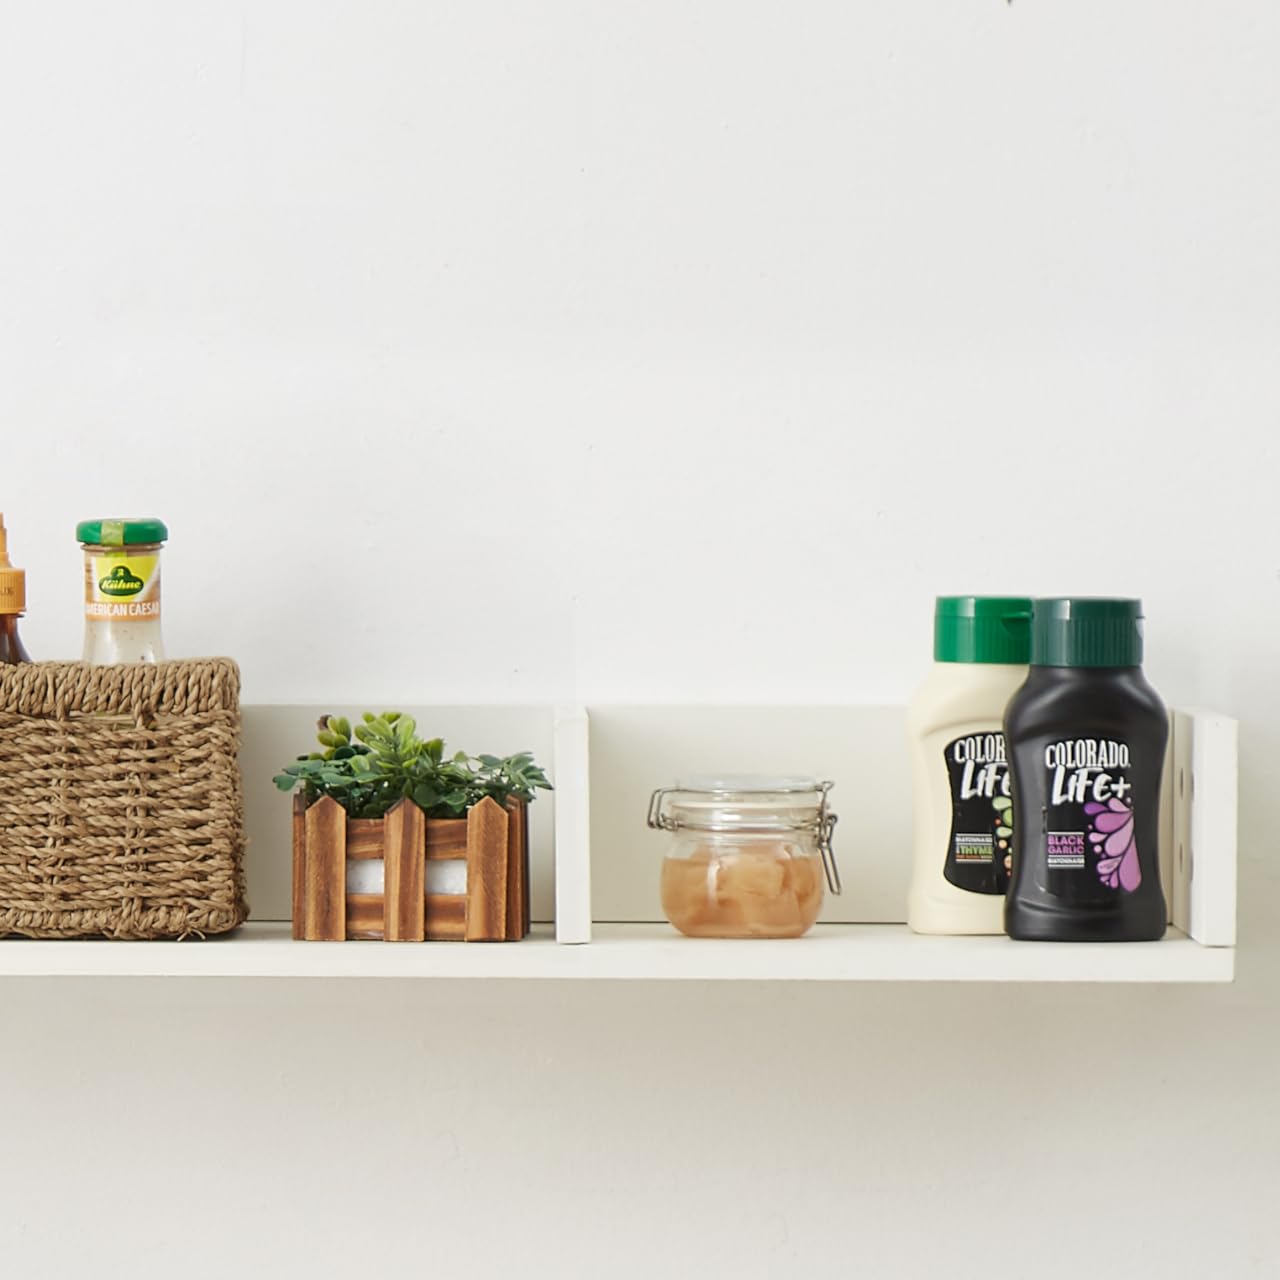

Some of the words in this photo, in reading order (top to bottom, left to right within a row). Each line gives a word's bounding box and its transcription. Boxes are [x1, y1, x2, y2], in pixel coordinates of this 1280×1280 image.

[101, 579, 141, 589] Kühne
[1045, 739, 1129, 768] COLORADO
[1048, 835, 1084, 845] BLACK
[1048, 845, 1084, 854] GARLIC
